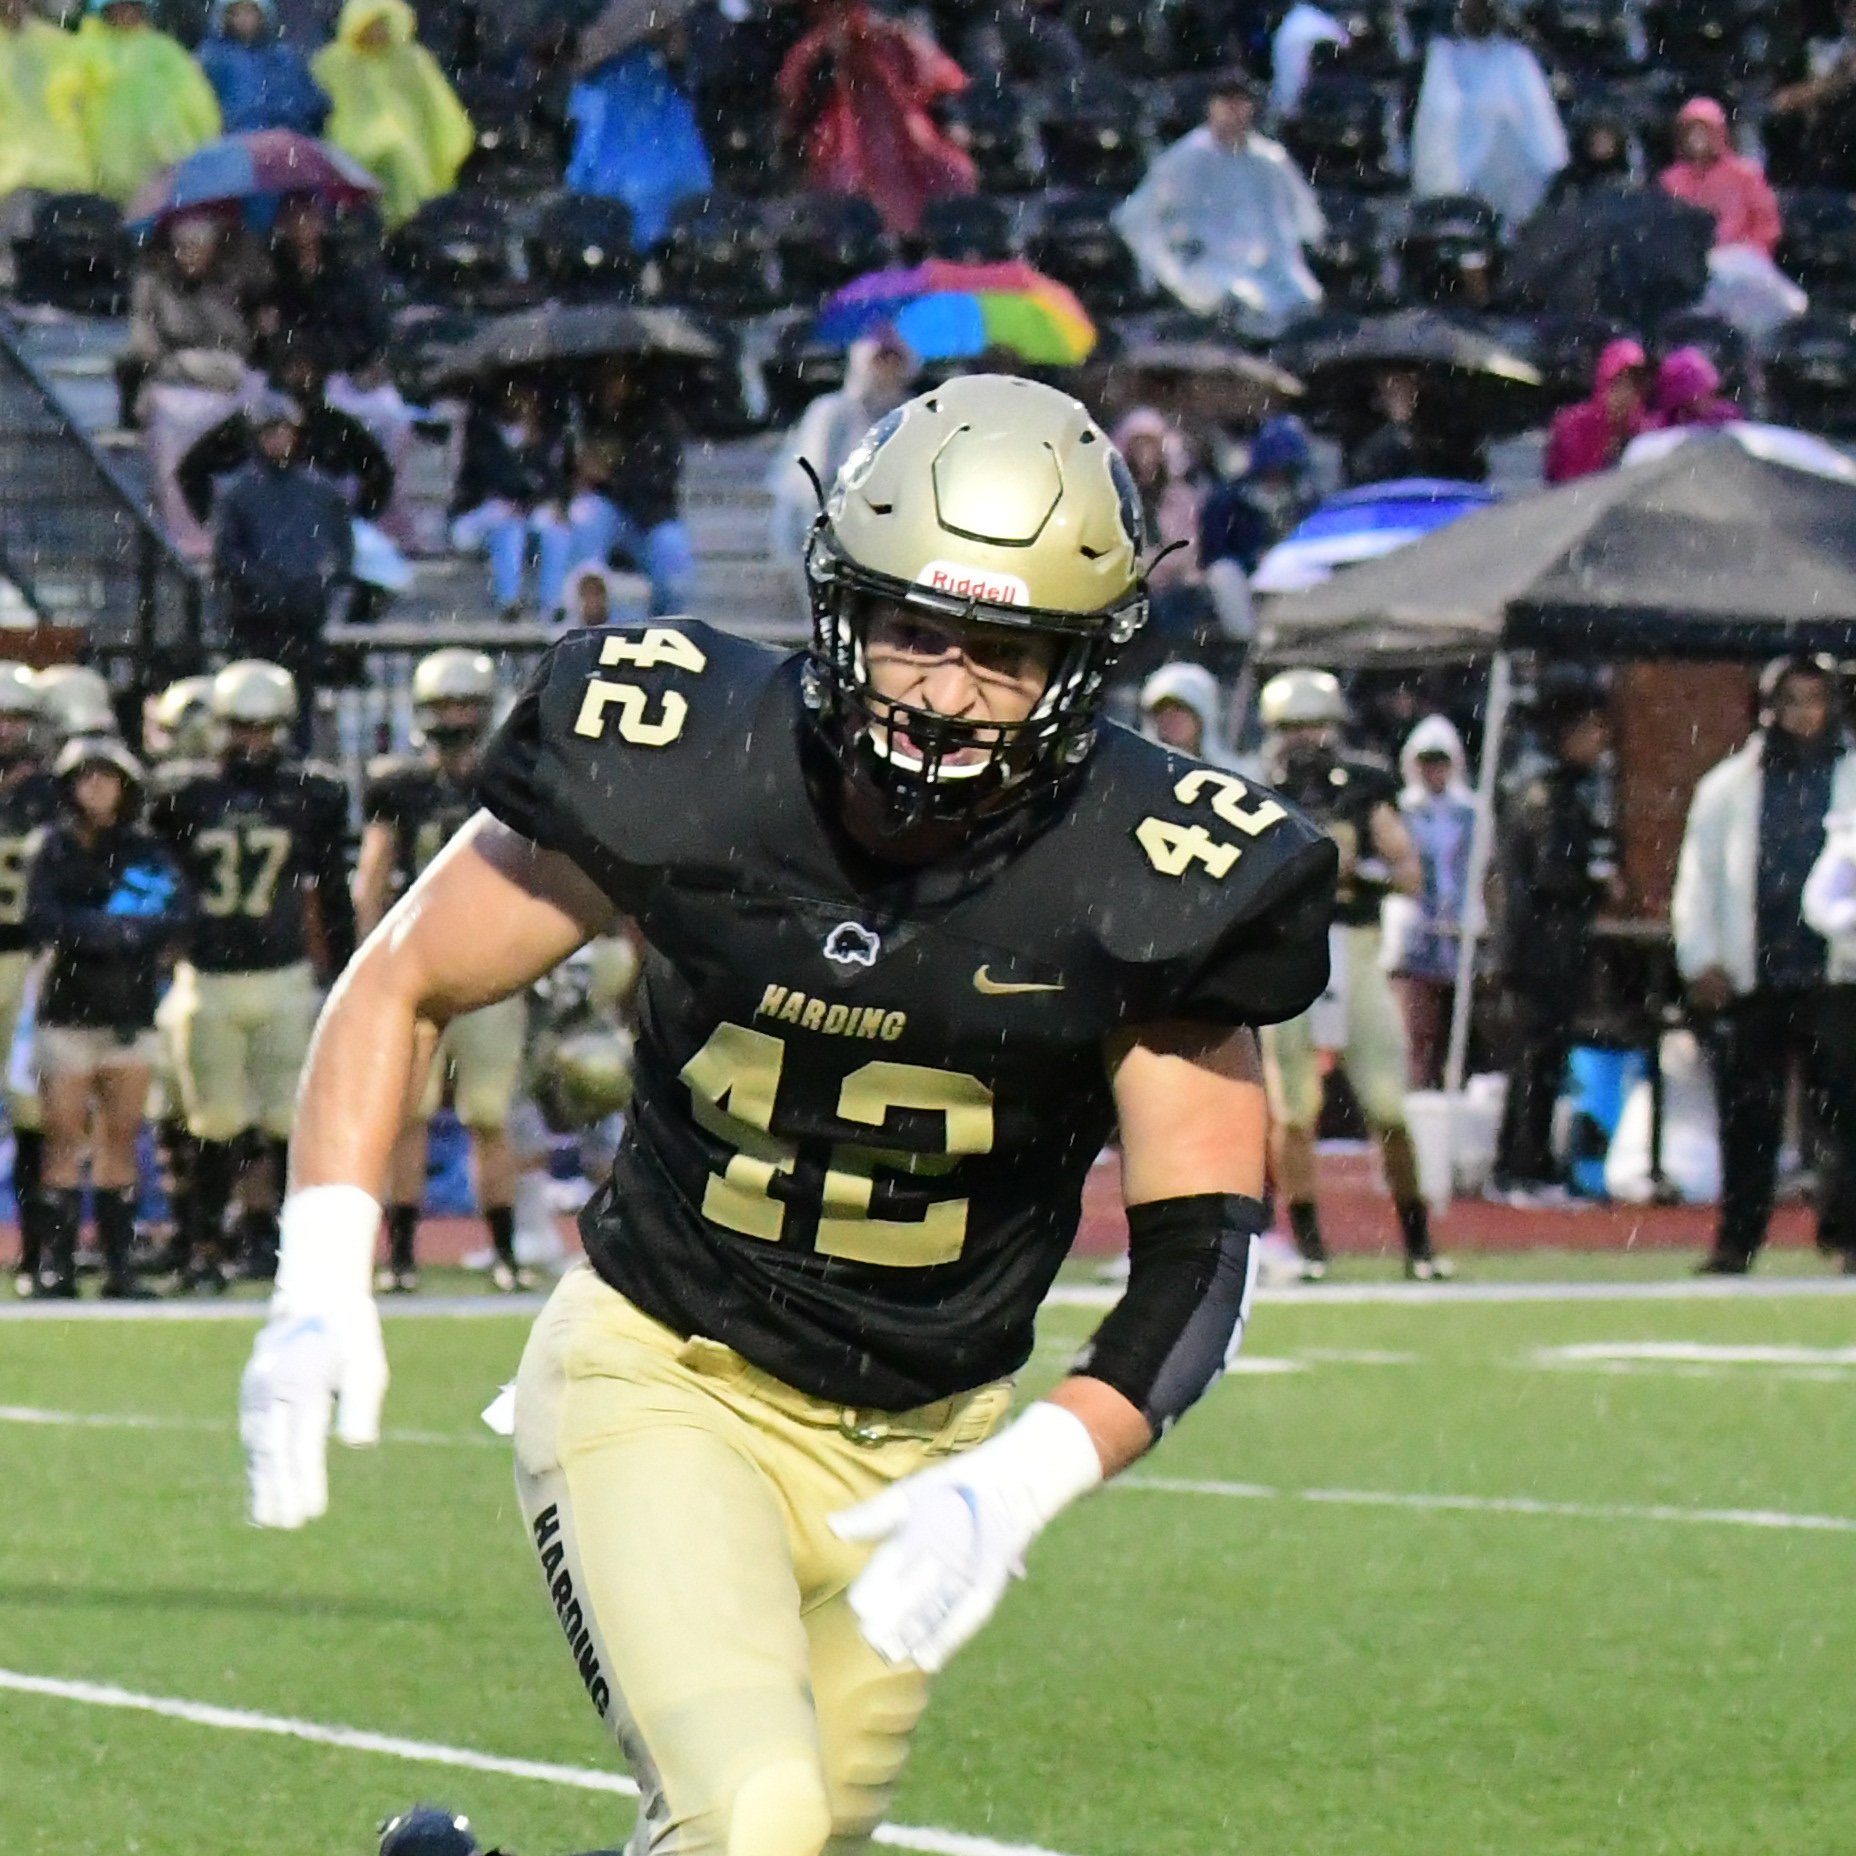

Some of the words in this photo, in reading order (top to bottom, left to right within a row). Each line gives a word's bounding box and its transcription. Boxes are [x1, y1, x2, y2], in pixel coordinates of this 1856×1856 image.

[933, 570, 1016, 606] Riddell
[574, 628, 707, 747] 42
[194, 826, 291, 918] 37
[1135, 769, 1288, 879] 42
[758, 983, 907, 1041] HARDING
[676, 1020, 995, 1268] 42
[533, 1502, 610, 1719] HARDING
